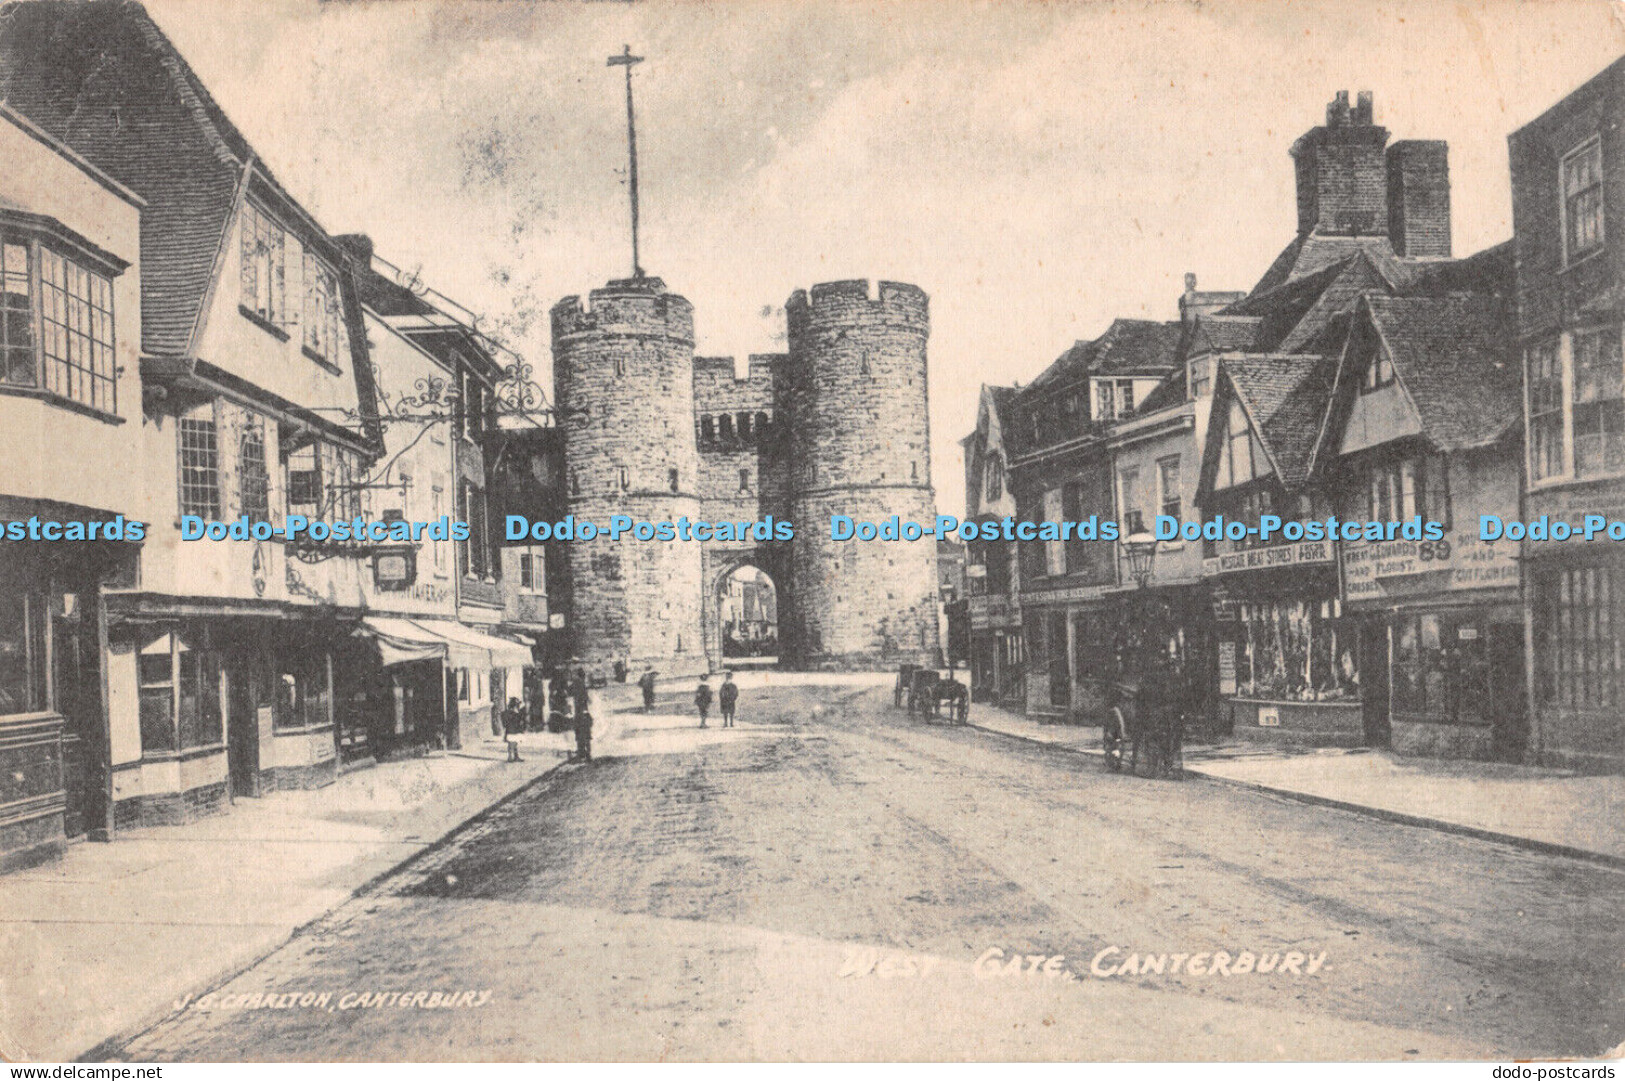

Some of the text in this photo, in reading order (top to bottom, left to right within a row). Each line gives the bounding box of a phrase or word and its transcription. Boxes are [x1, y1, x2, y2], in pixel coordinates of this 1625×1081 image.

[1247, 551, 1264, 567] MEAT
[1266, 547, 1291, 565] STORES
[1299, 550, 1327, 561] PORK
[1419, 541, 1452, 561] 89
